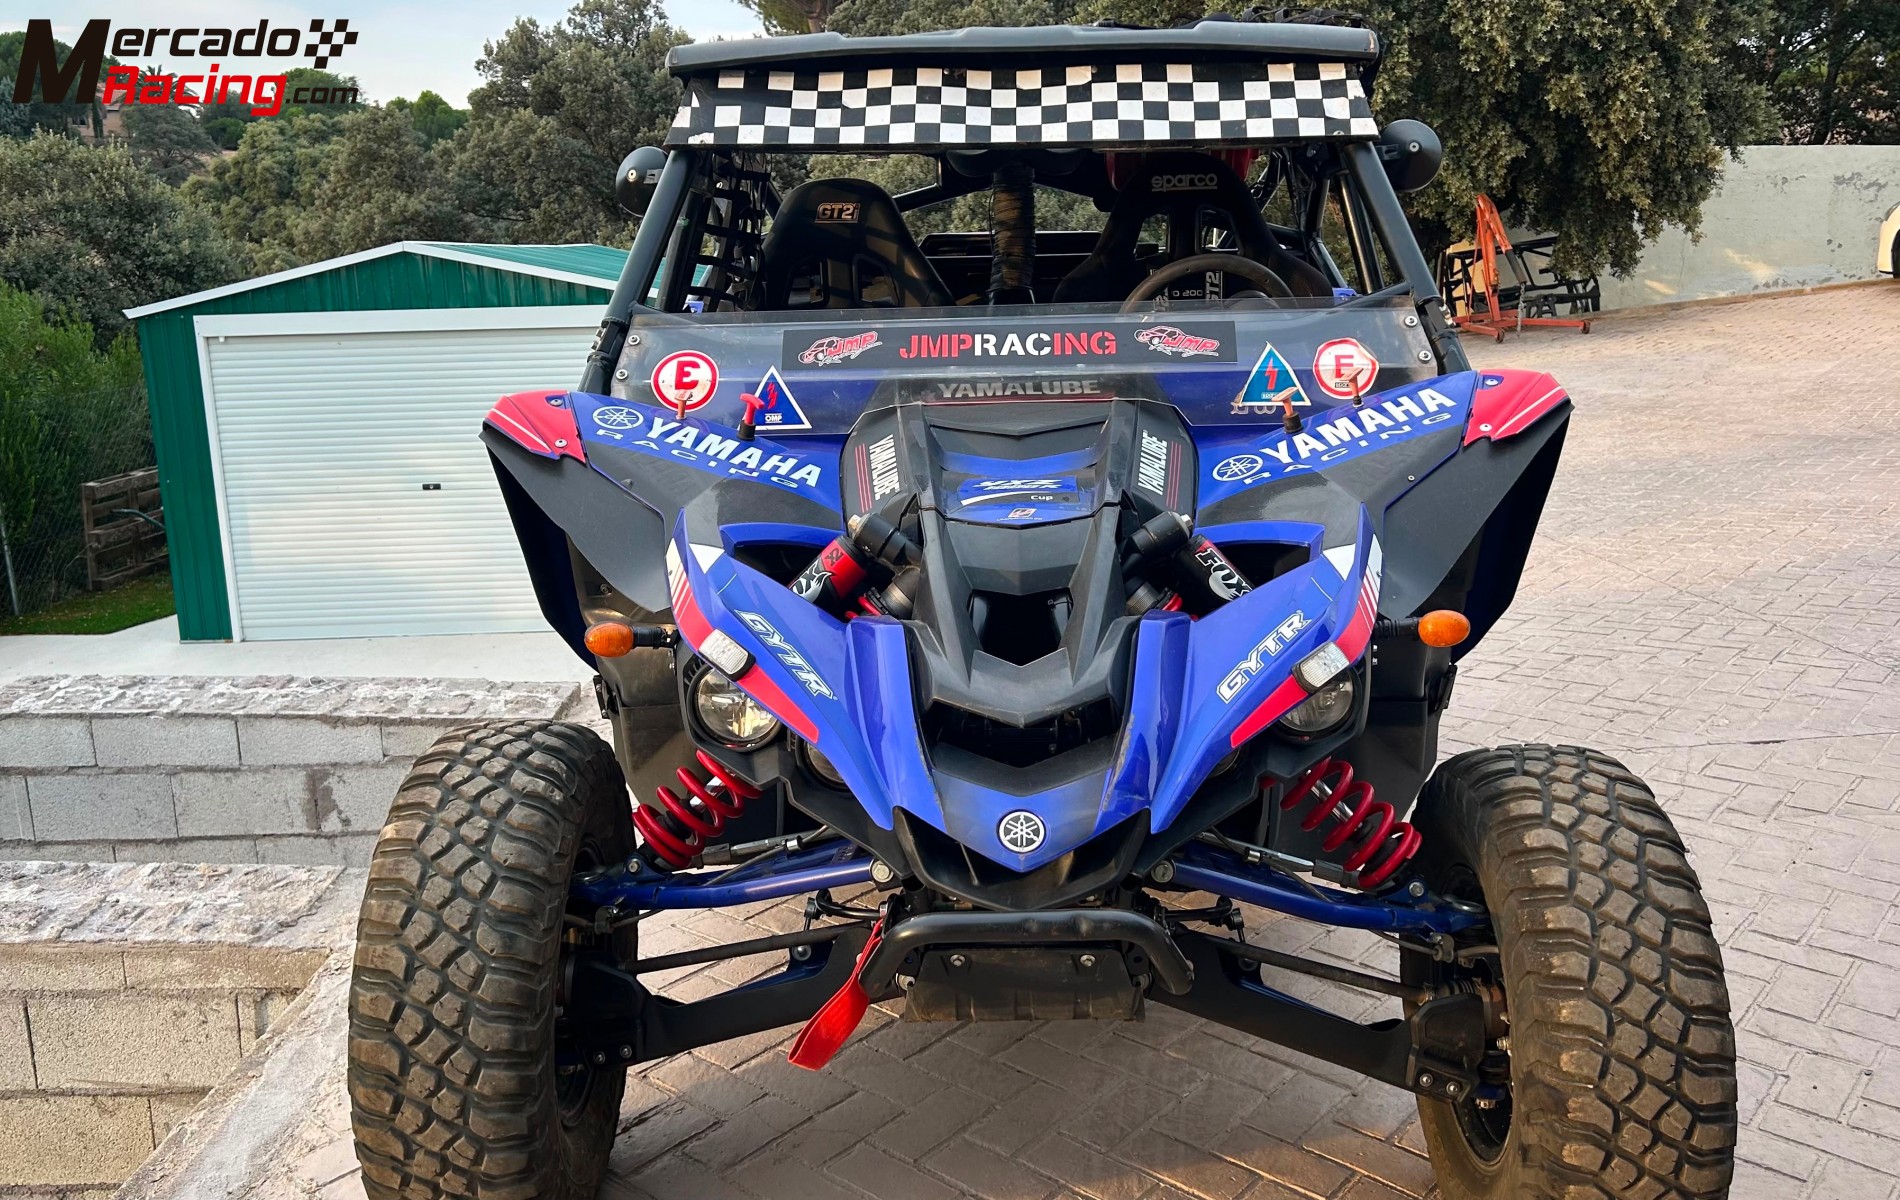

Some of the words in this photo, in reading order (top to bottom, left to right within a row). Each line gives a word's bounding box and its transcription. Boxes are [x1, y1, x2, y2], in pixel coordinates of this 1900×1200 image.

[1151, 173, 1217, 192] sparco
[826, 331, 878, 357] JMP
[1162, 334, 1219, 352] JMP
[1334, 354, 1354, 379] E
[675, 360, 701, 391] E
[937, 380, 1101, 399] YAMALUBE
[764, 413, 783, 424] OMP
[1259, 387, 1457, 464] YAMAHA
[595, 429, 799, 489] RACING
[646, 416, 822, 488] YAMAHA
[869, 434, 900, 500] YAMALUBE
[1138, 429, 1168, 495] YAMALUBE
[1243, 412, 1452, 485] RACING
[1195, 547, 1253, 601] FOX
[734, 609, 834, 700] GYTR
[1216, 610, 1312, 704] GYTR
